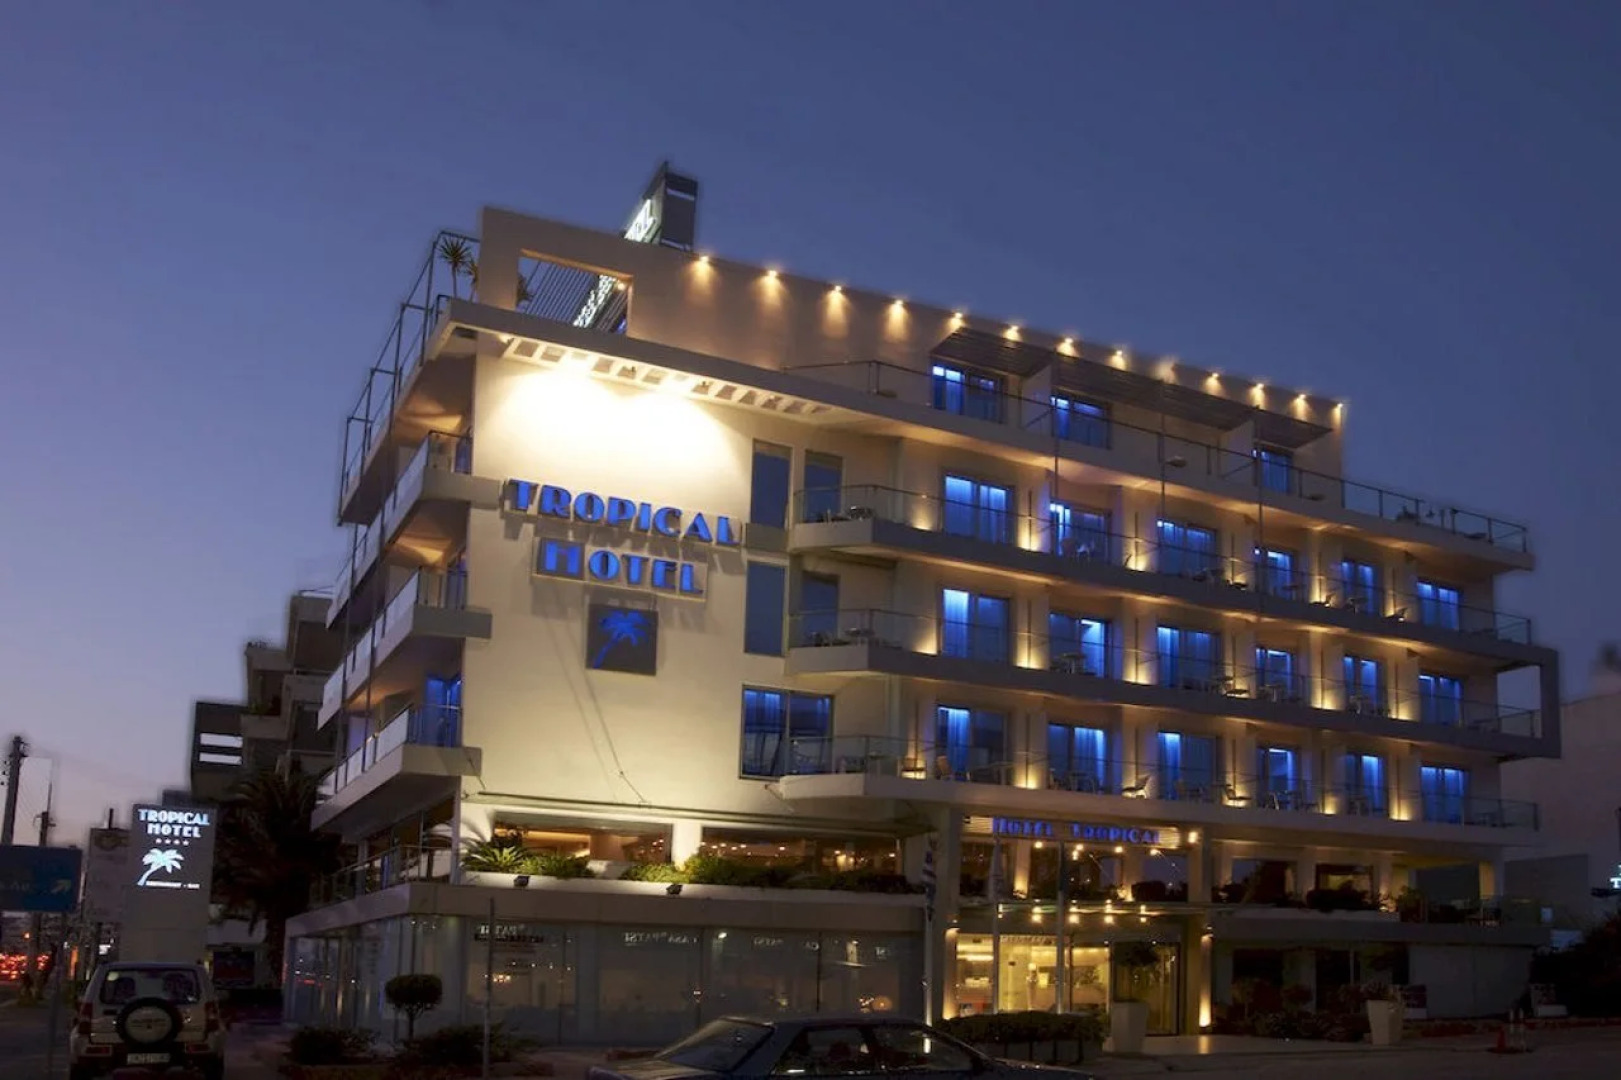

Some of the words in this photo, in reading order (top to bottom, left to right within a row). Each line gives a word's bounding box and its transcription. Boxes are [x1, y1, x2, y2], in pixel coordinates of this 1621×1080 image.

[506, 478, 741, 546] TROPICAL
[536, 537, 704, 595] HOTEL
[137, 808, 210, 826] TROPICAL
[992, 816, 1053, 837] HOTEL
[146, 822, 202, 838] HOTEL
